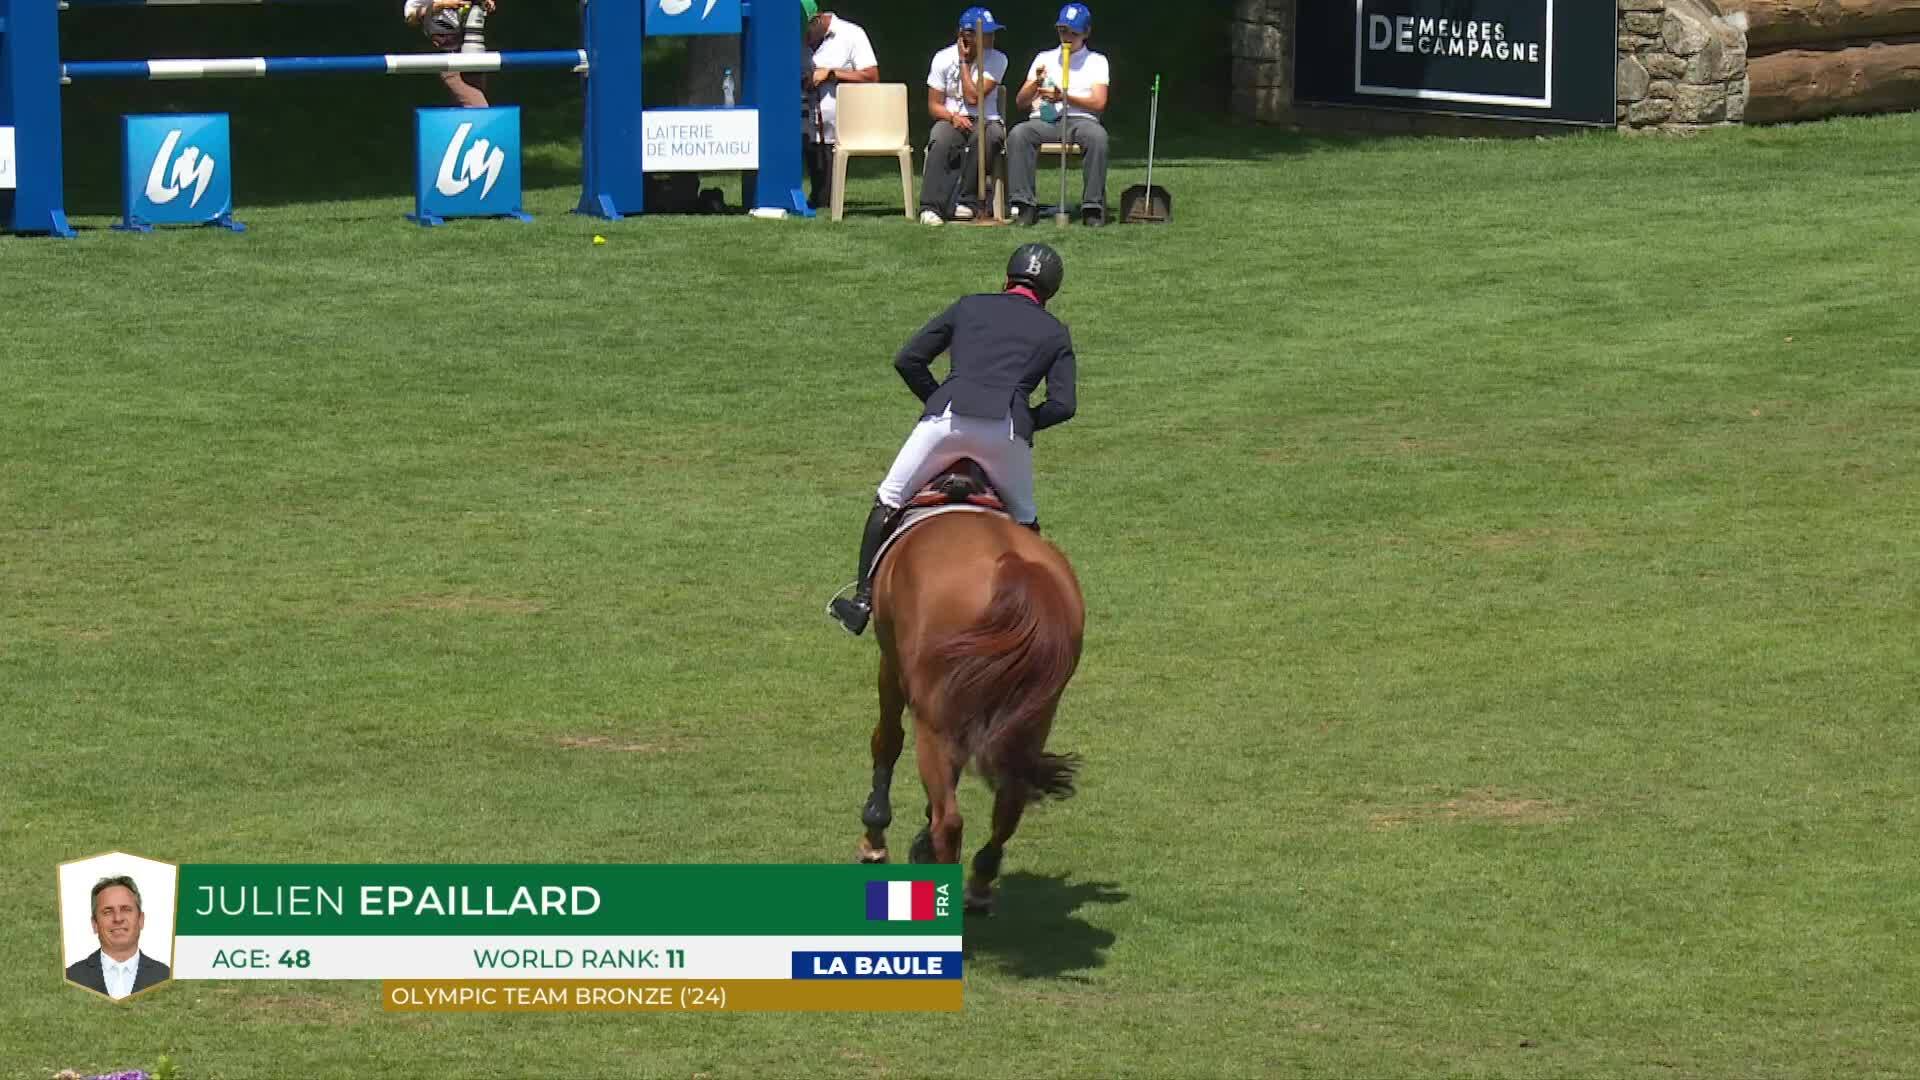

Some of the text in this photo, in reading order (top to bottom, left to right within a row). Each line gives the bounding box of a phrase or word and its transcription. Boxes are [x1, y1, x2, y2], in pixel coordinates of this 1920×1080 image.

[1418, 17, 1505, 41] MEURES
[1418, 36, 1539, 62] CAMPAGNE
[647, 124, 713, 141] LAITERIE
[647, 140, 751, 157] DE MONTAIGU
